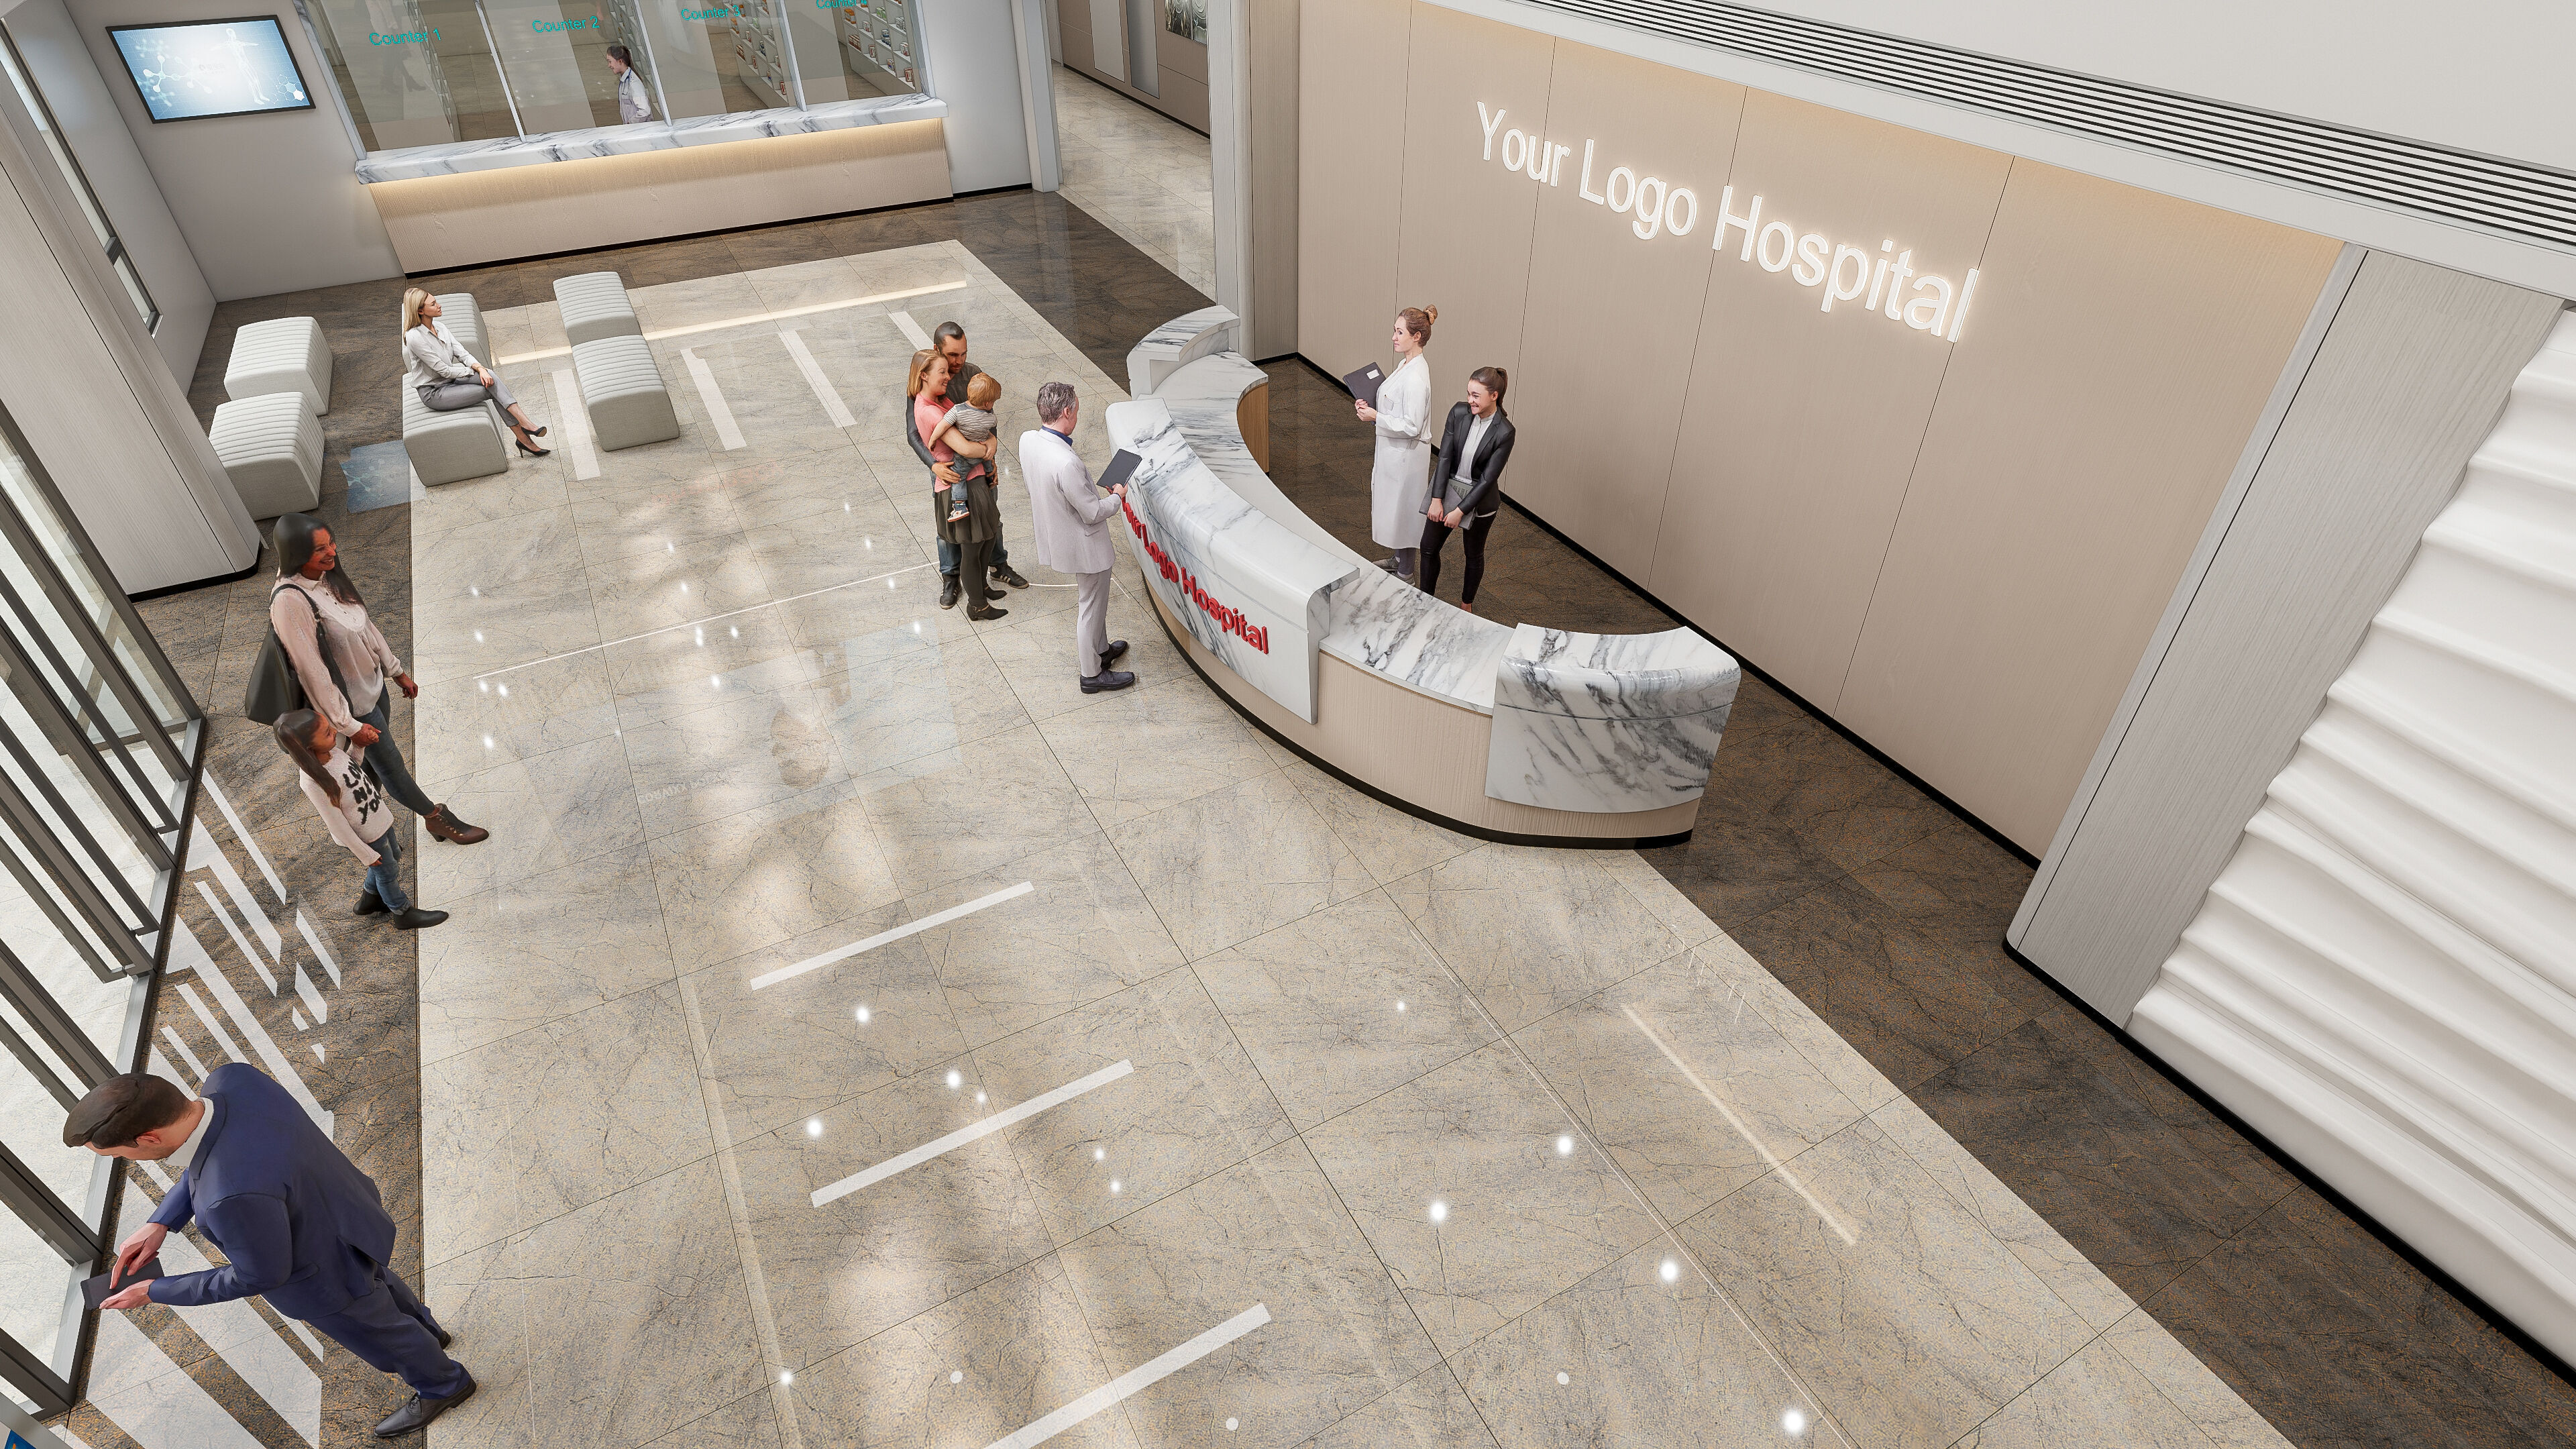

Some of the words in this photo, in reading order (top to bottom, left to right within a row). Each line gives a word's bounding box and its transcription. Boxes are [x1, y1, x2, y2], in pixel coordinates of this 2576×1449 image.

[681, 7, 729, 20] Counter
[732, 5, 740, 16] 3
[532, 19, 586, 32] Counter
[590, 15, 600, 28] 2
[369, 31, 428, 46] Counter
[433, 28, 441, 41] 1
[1477, 101, 1570, 187] Your
[1578, 138, 1697, 240] Logo
[1712, 185, 1980, 343] Hospital
[1141, 524, 1179, 583] Logo
[1181, 567, 1269, 655] Hospital
